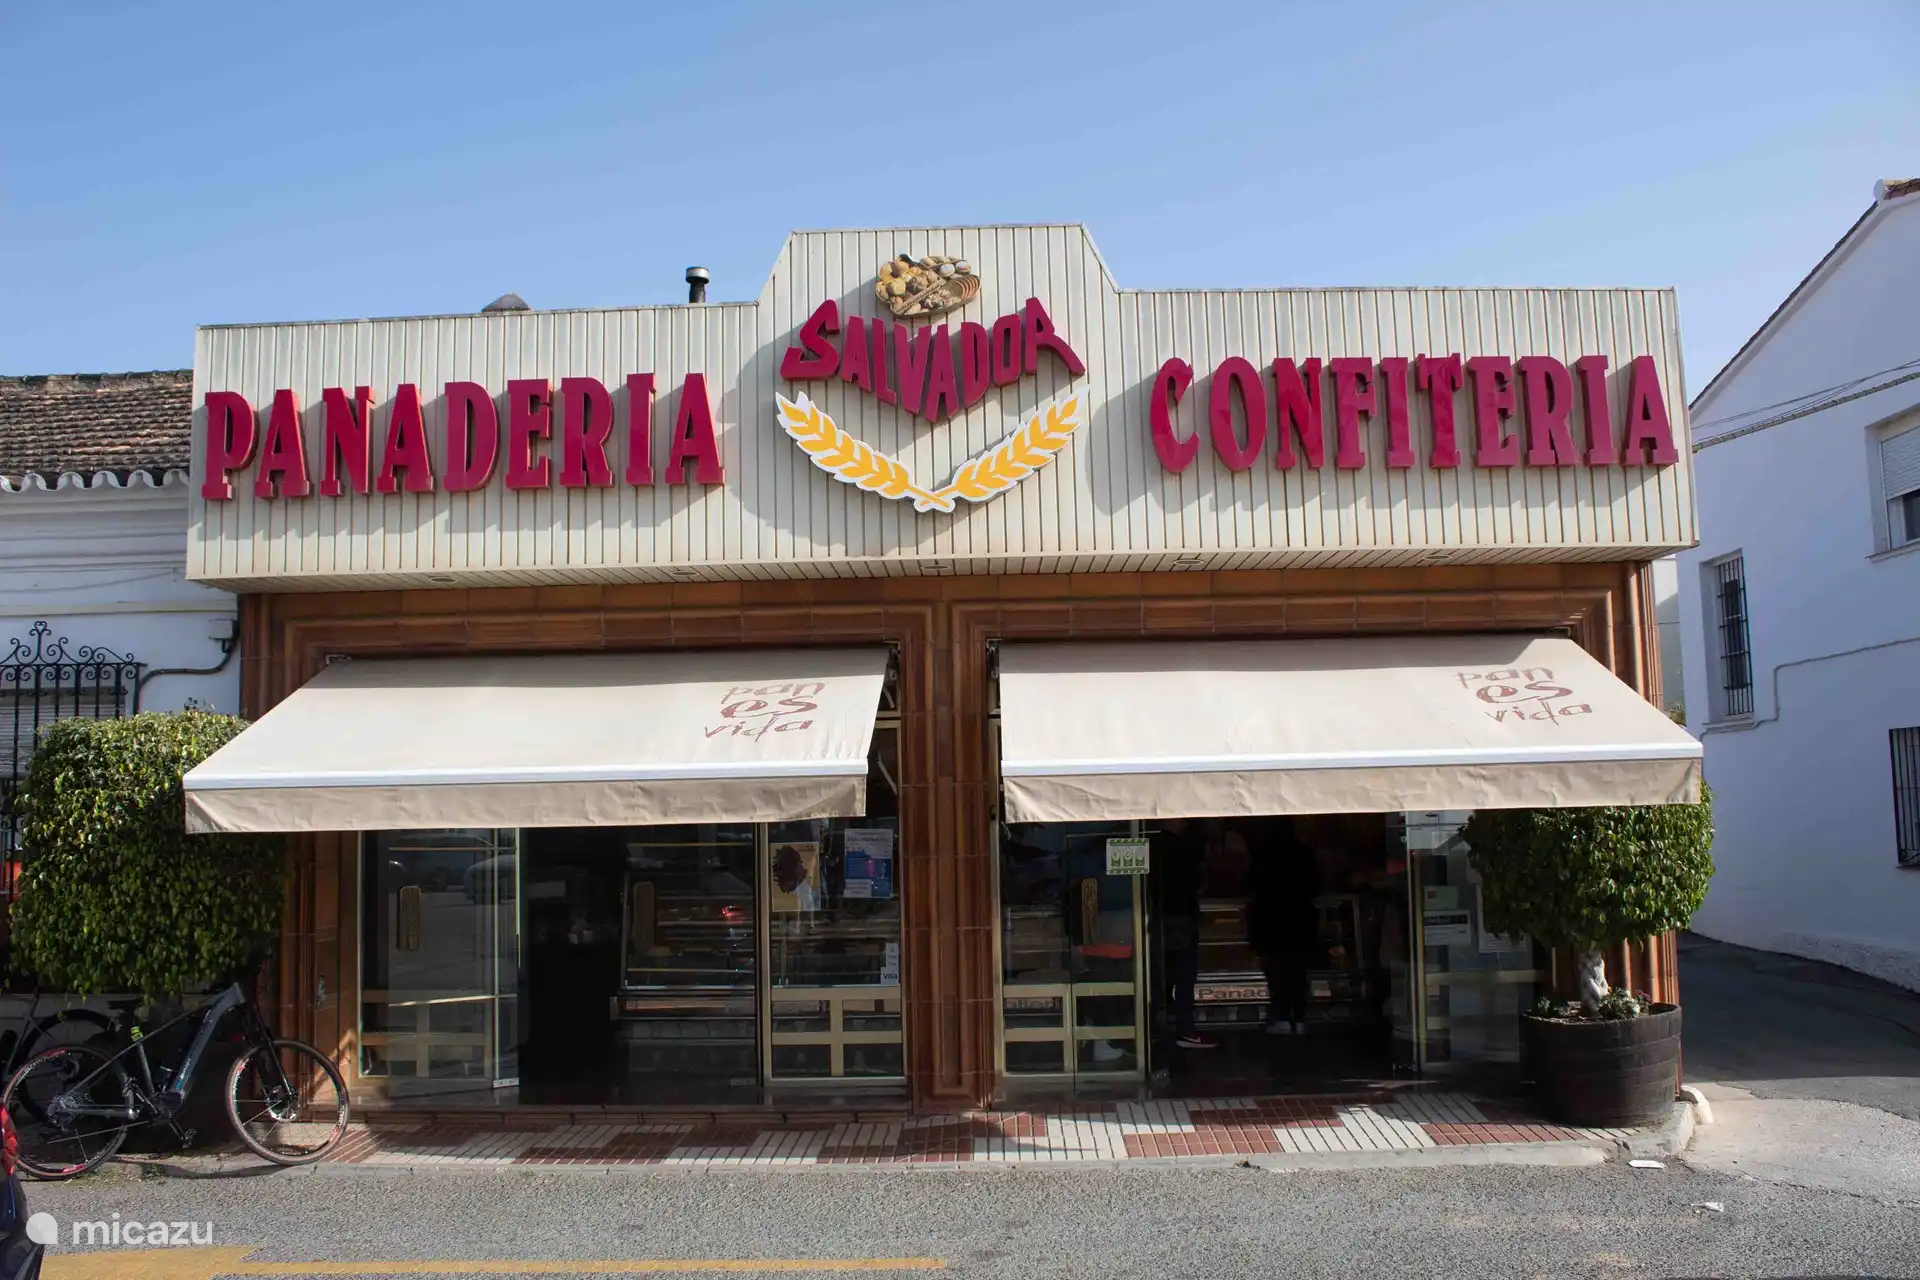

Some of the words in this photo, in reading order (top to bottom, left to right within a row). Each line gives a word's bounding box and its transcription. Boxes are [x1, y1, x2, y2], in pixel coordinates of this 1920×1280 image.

[780, 297, 1086, 423] SALVADOR
[1150, 353, 1679, 473] CONFITERIA
[202, 372, 725, 499] PANADERIA
[1453, 667, 1554, 689] pan
[721, 682, 826, 704] pan
[1476, 680, 1573, 703] es
[720, 695, 818, 718] es
[1484, 700, 1593, 726] vida
[704, 713, 814, 742] vida
